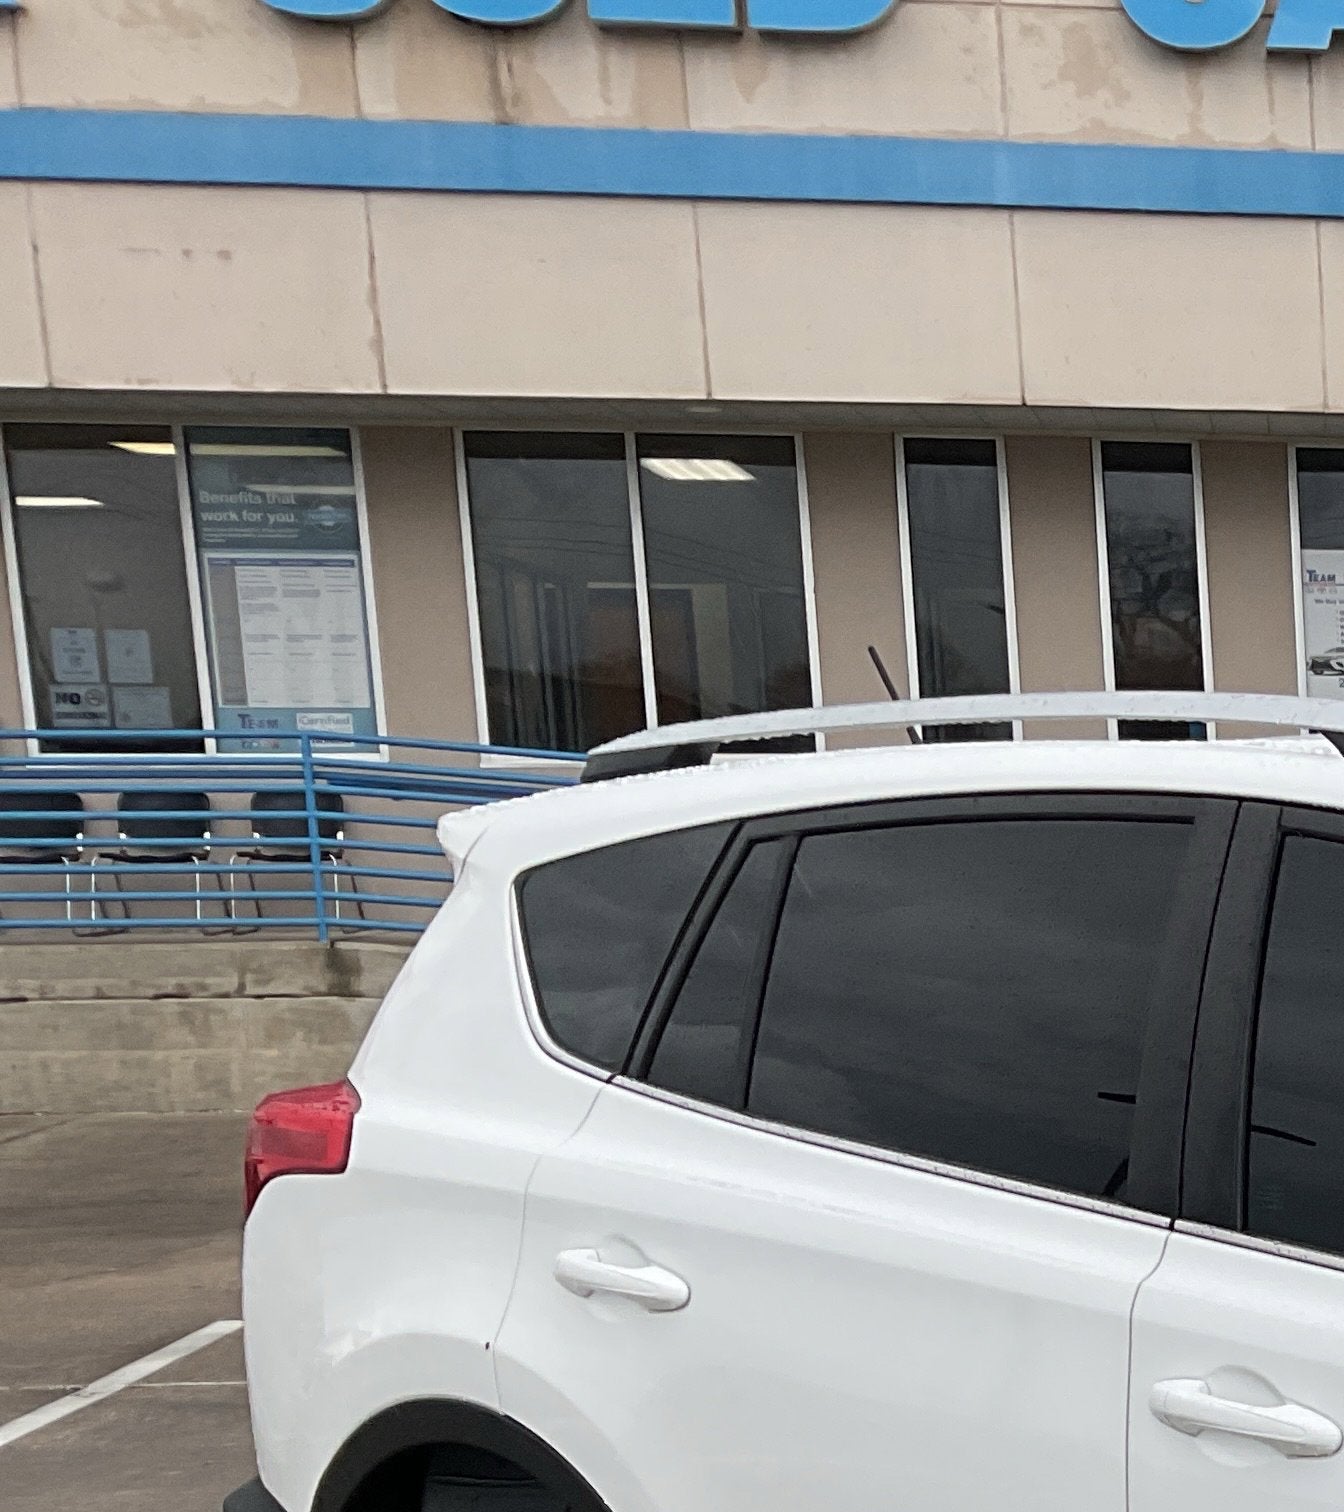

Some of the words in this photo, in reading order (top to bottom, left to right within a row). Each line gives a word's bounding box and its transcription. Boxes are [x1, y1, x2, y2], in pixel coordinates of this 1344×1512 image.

[200, 491, 262, 504] Benefits
[265, 492, 296, 504] that
[200, 510, 239, 522] work
[242, 510, 262, 522] for
